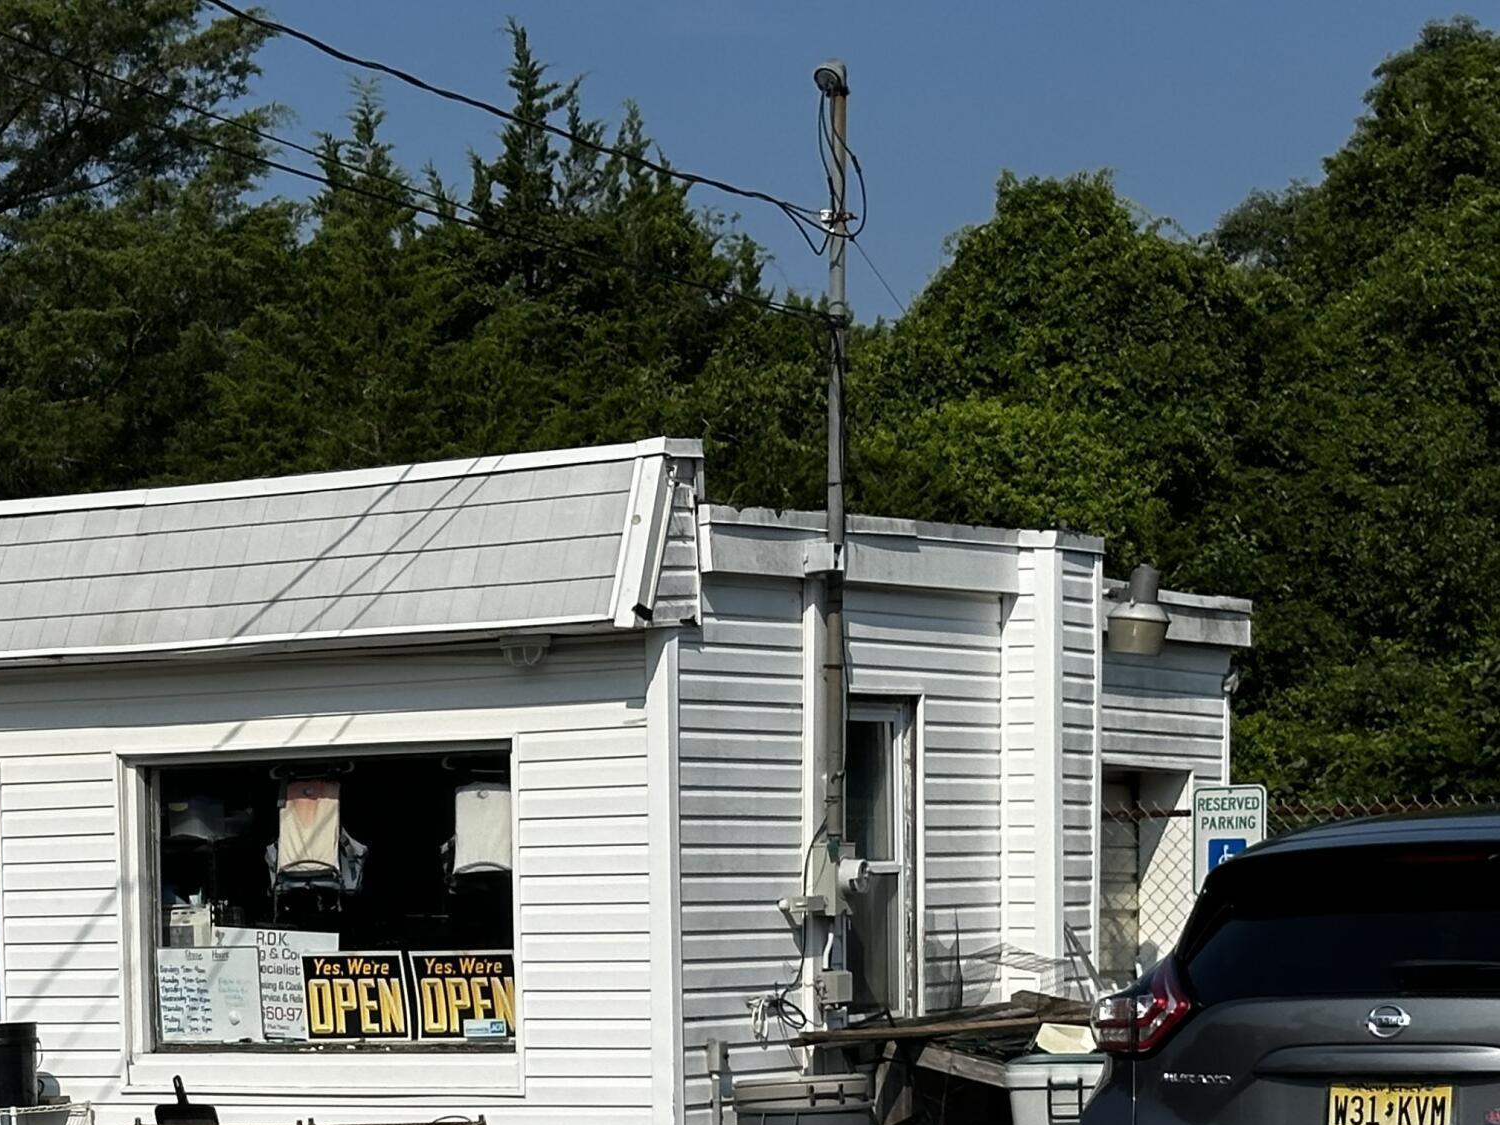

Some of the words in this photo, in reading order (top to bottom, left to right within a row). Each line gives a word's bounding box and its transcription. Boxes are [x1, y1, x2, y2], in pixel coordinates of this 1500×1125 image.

[1198, 796, 1260, 811] RESERVED
[1201, 815, 1256, 830] PARKING
[313, 957, 344, 976] Yes,
[348, 957, 390, 975] We're
[424, 957, 456, 975] Yes,
[459, 957, 503, 974] We're
[308, 978, 405, 1034] OPEN
[420, 976, 516, 1034] OPEN
[1334, 1095, 1380, 1125] W31
